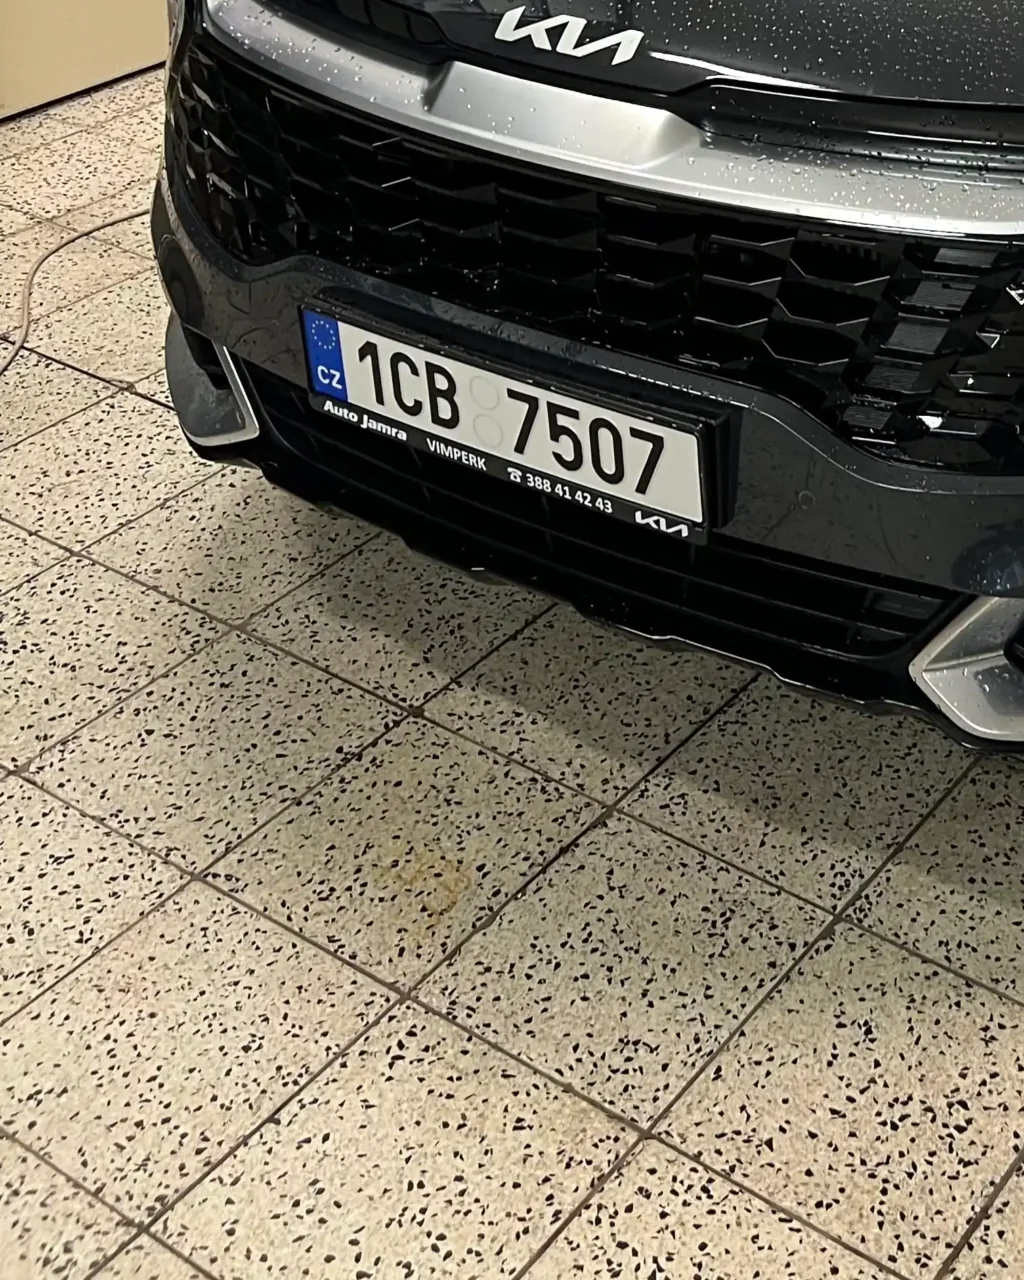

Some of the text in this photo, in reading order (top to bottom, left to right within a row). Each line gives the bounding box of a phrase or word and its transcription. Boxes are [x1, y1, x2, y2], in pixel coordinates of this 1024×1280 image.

[495, 5, 645, 66] KIA
[317, 365, 343, 390] CZ
[357, 340, 665, 496] 1CB 7507
[323, 400, 613, 514] Auto Jamra VIMPERK 388 41 42 43
[634, 510, 689, 538] KIA
